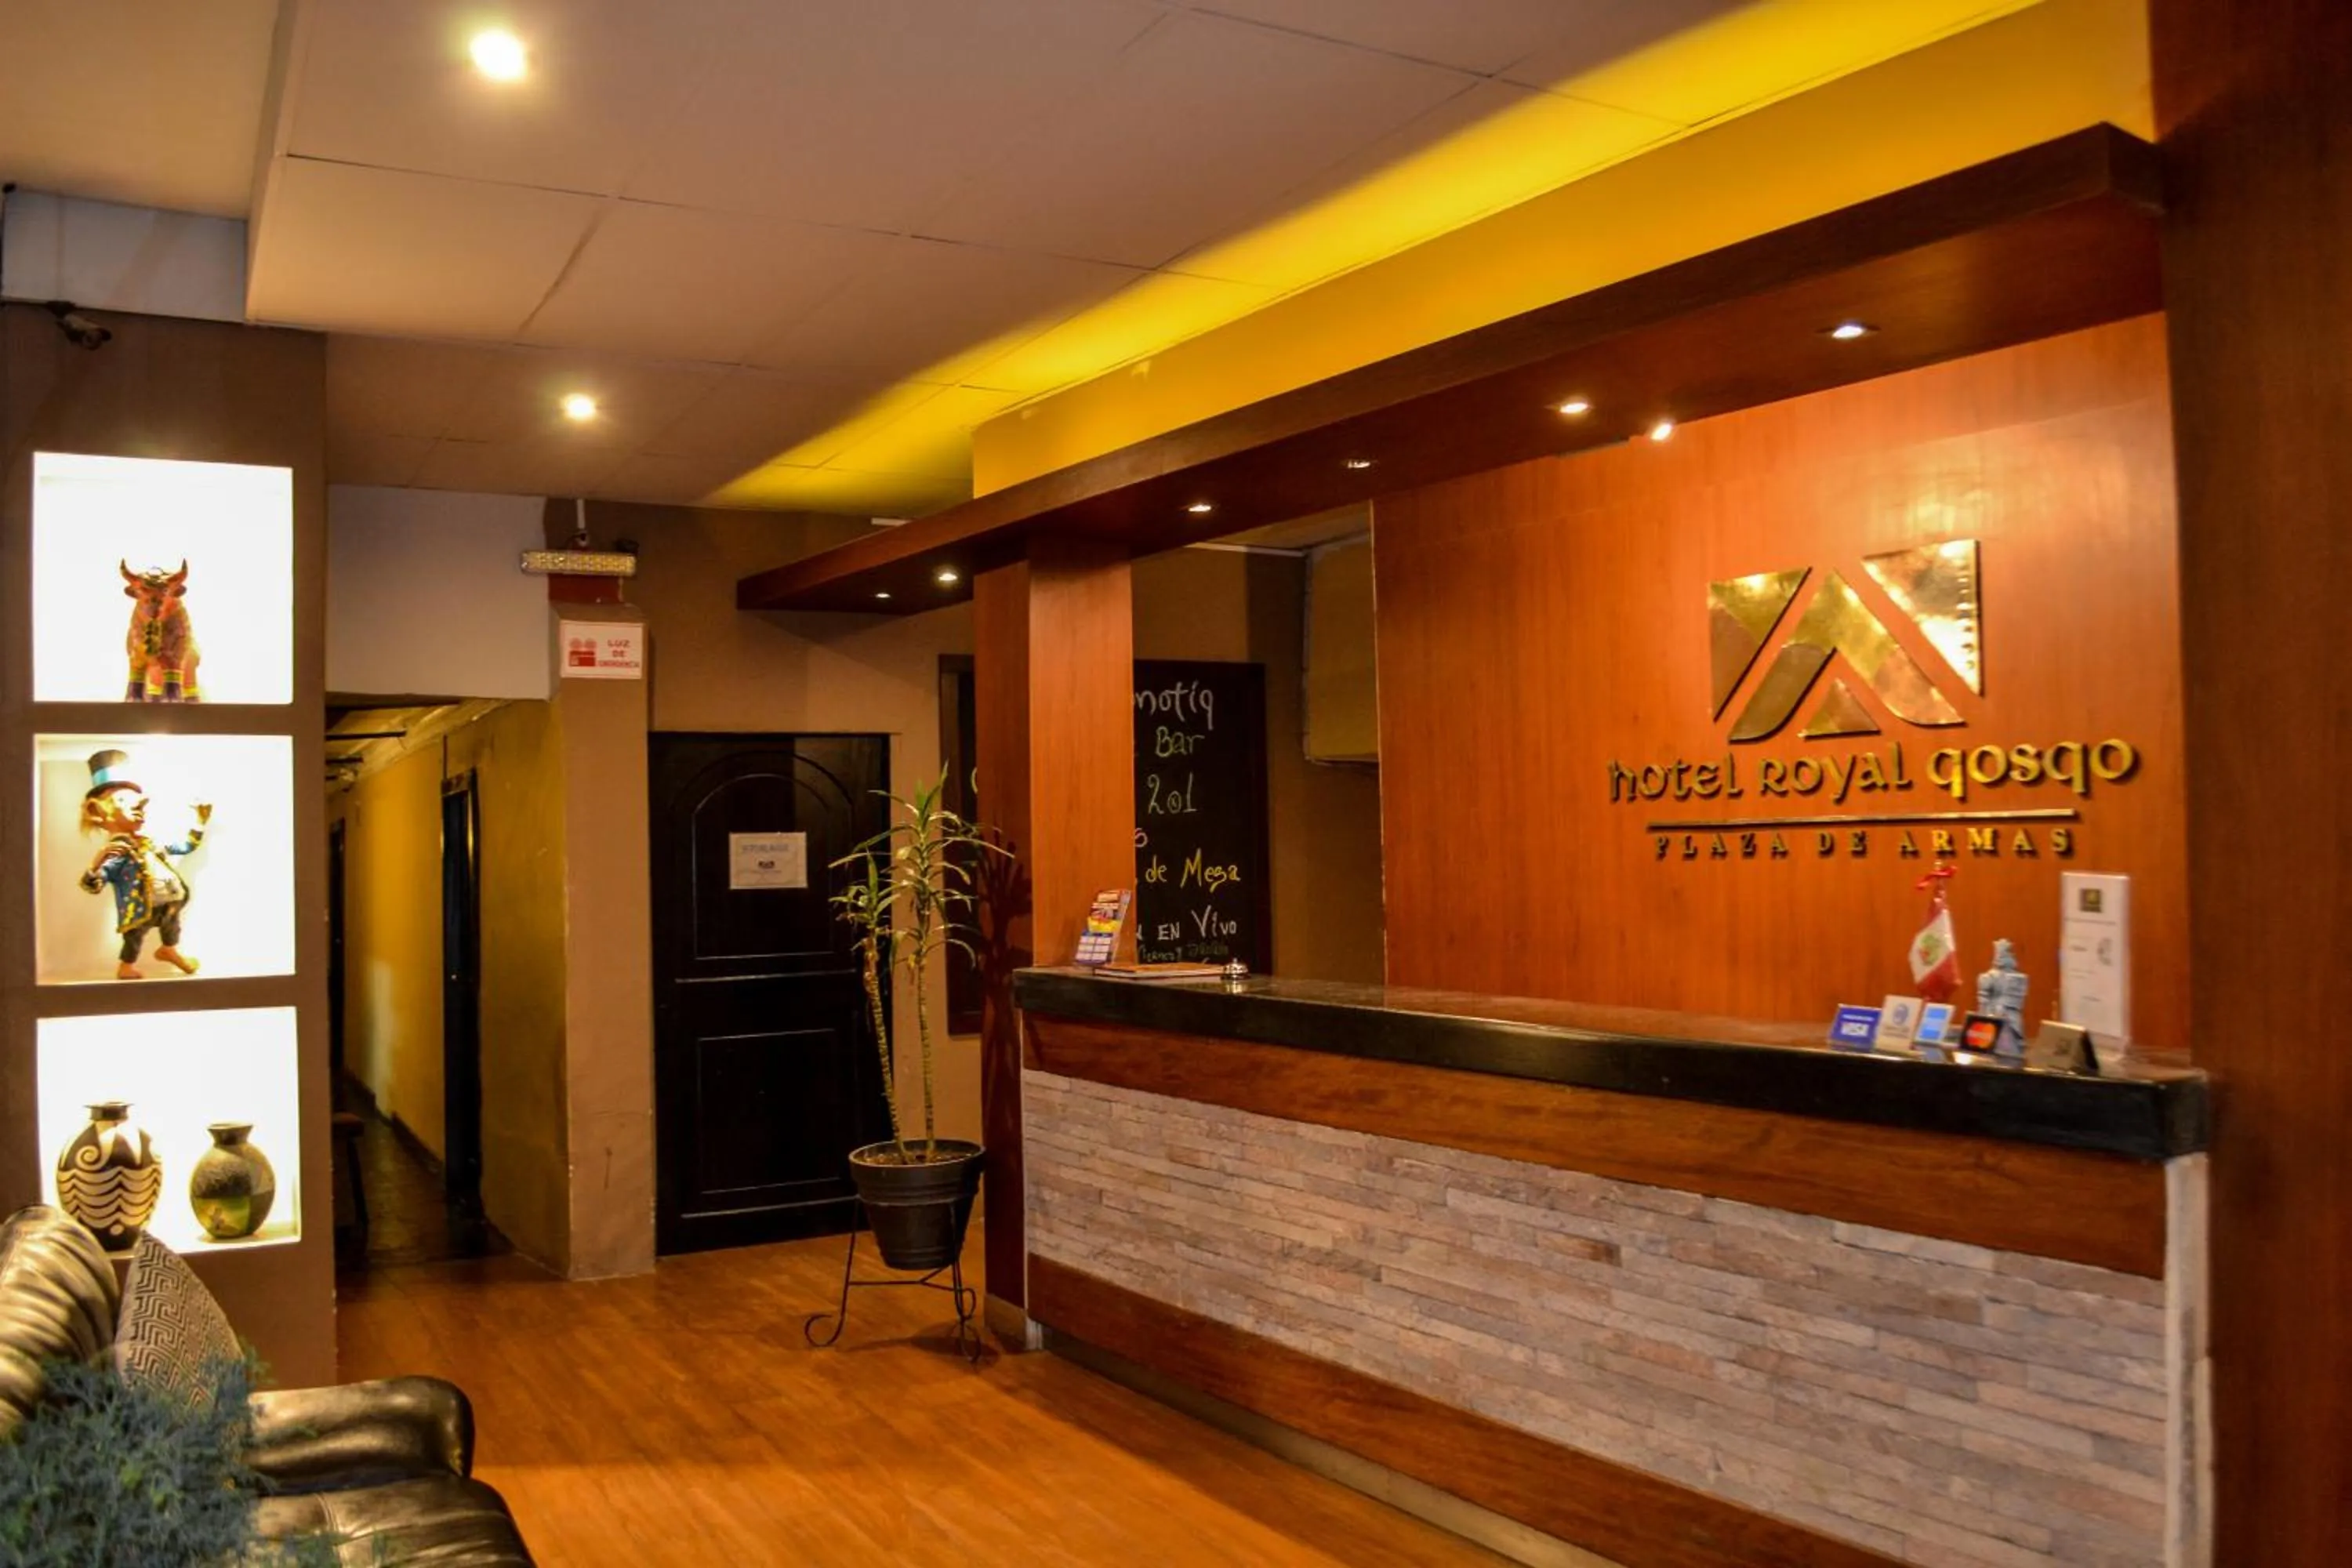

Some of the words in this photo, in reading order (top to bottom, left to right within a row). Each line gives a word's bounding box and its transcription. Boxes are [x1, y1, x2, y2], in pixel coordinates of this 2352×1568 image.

[1155, 726, 1205, 757] Bar
[1655, 831, 1790, 861] PLAZA
[1817, 830, 1868, 858] DE
[1899, 827, 2075, 860] ARMAS
[1145, 855, 1167, 883] de
[1157, 921, 1181, 940] EN
